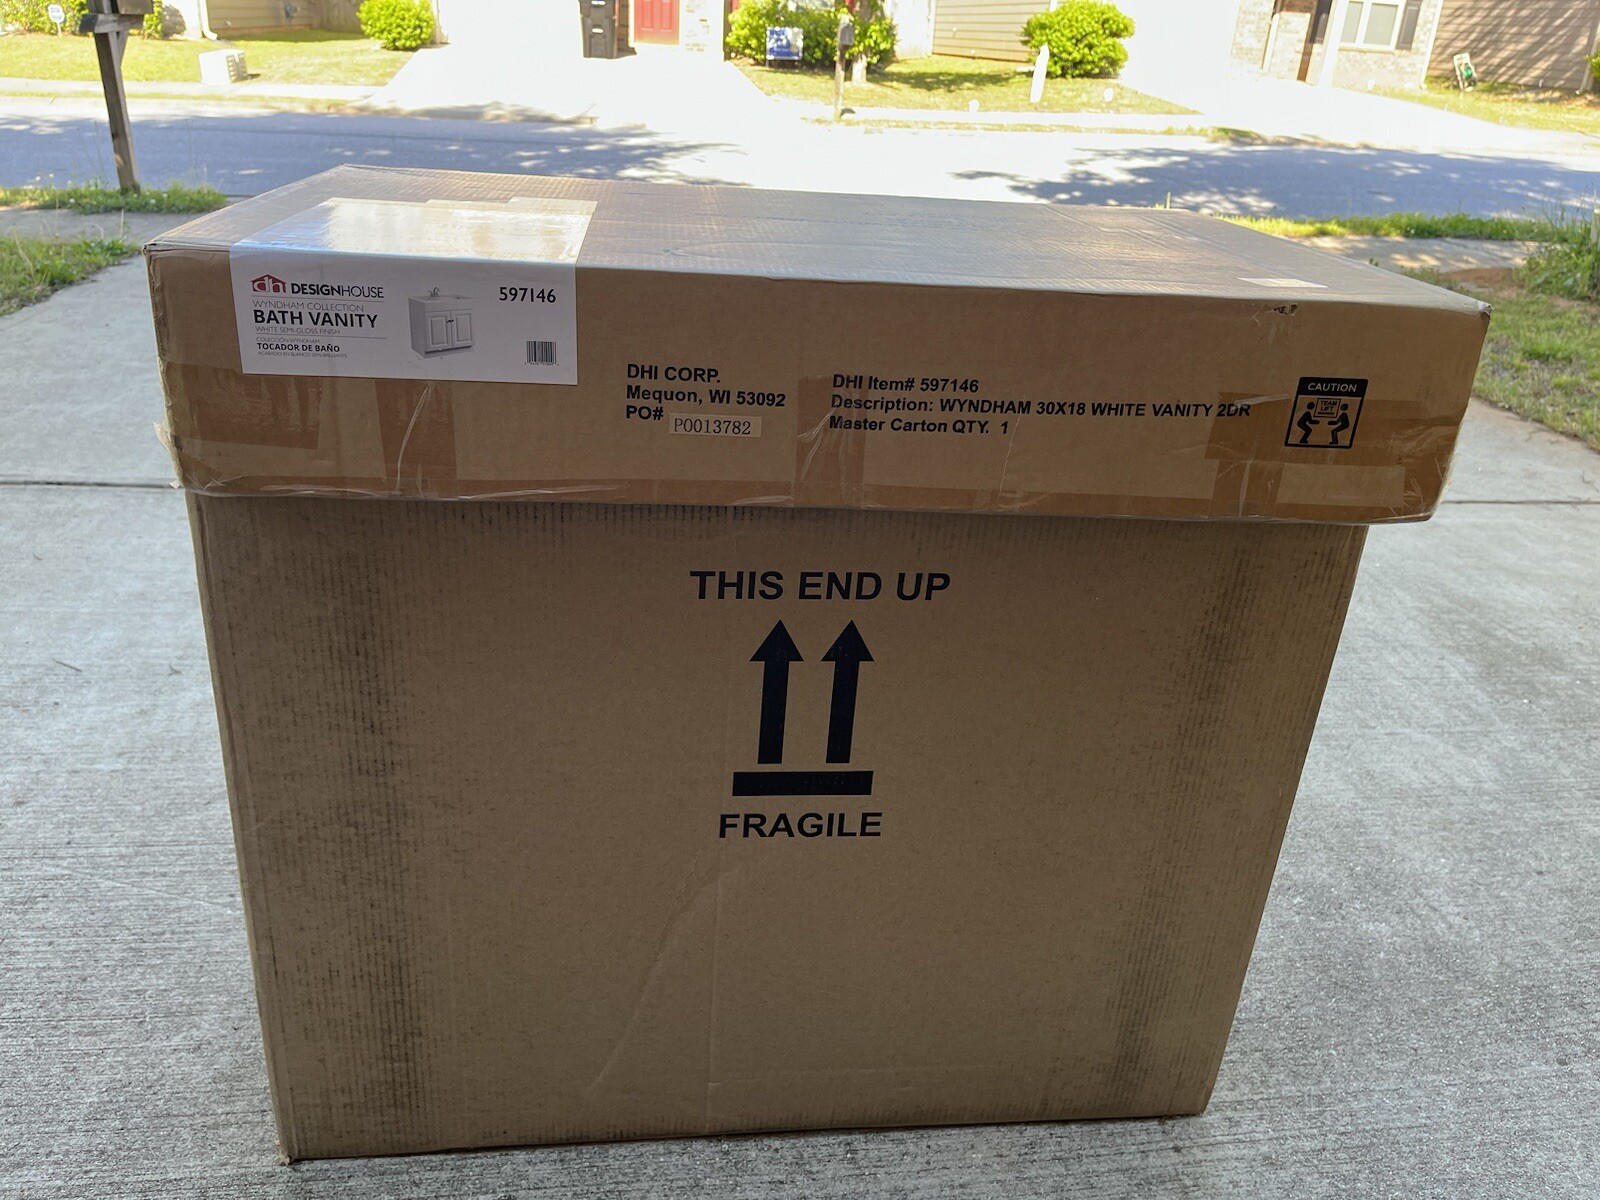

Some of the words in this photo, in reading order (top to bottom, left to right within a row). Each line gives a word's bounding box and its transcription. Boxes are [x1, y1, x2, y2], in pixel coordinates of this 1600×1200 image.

[291, 283, 384, 299] DESIGNHOUSE
[499, 286, 556, 303] 597146
[252, 300, 304, 310] WYNDHAM
[307, 302, 365, 312] COLLECTION
[253, 309, 303, 325] BATH
[308, 311, 378, 328] VANITY
[280, 327, 318, 335] SEMI-GLOSS
[257, 342, 300, 351] TOCADOR
[302, 344, 312, 352] DE
[315, 343, 340, 352] BAÑO
[626, 363, 659, 381] DHI
[664, 366, 721, 384] CORP.
[832, 374, 863, 390] DHI
[868, 375, 915, 392] Item#
[920, 378, 979, 393] 597146
[1307, 382, 1358, 392] CAUTION
[626, 385, 703, 405] Mequon,
[709, 389, 731, 404] WI
[736, 391, 786, 407] 53092
[626, 405, 664, 421] PO#
[830, 394, 934, 414] Description:
[939, 398, 1032, 416] WYNDHAM
[1036, 401, 1086, 416] 30X18
[1091, 402, 1146, 417] WHITE
[1152, 403, 1214, 418] VANITY
[1216, 404, 1251, 418] 2DR
[829, 415, 887, 431] Master
[890, 418, 948, 433] Carton
[952, 420, 990, 435] QTY.
[1000, 421, 1009, 434] 1
[690, 570, 784, 600] THIS
[798, 571, 883, 600] END
[896, 572, 951, 601] UP
[719, 812, 883, 839] FRAGILE
